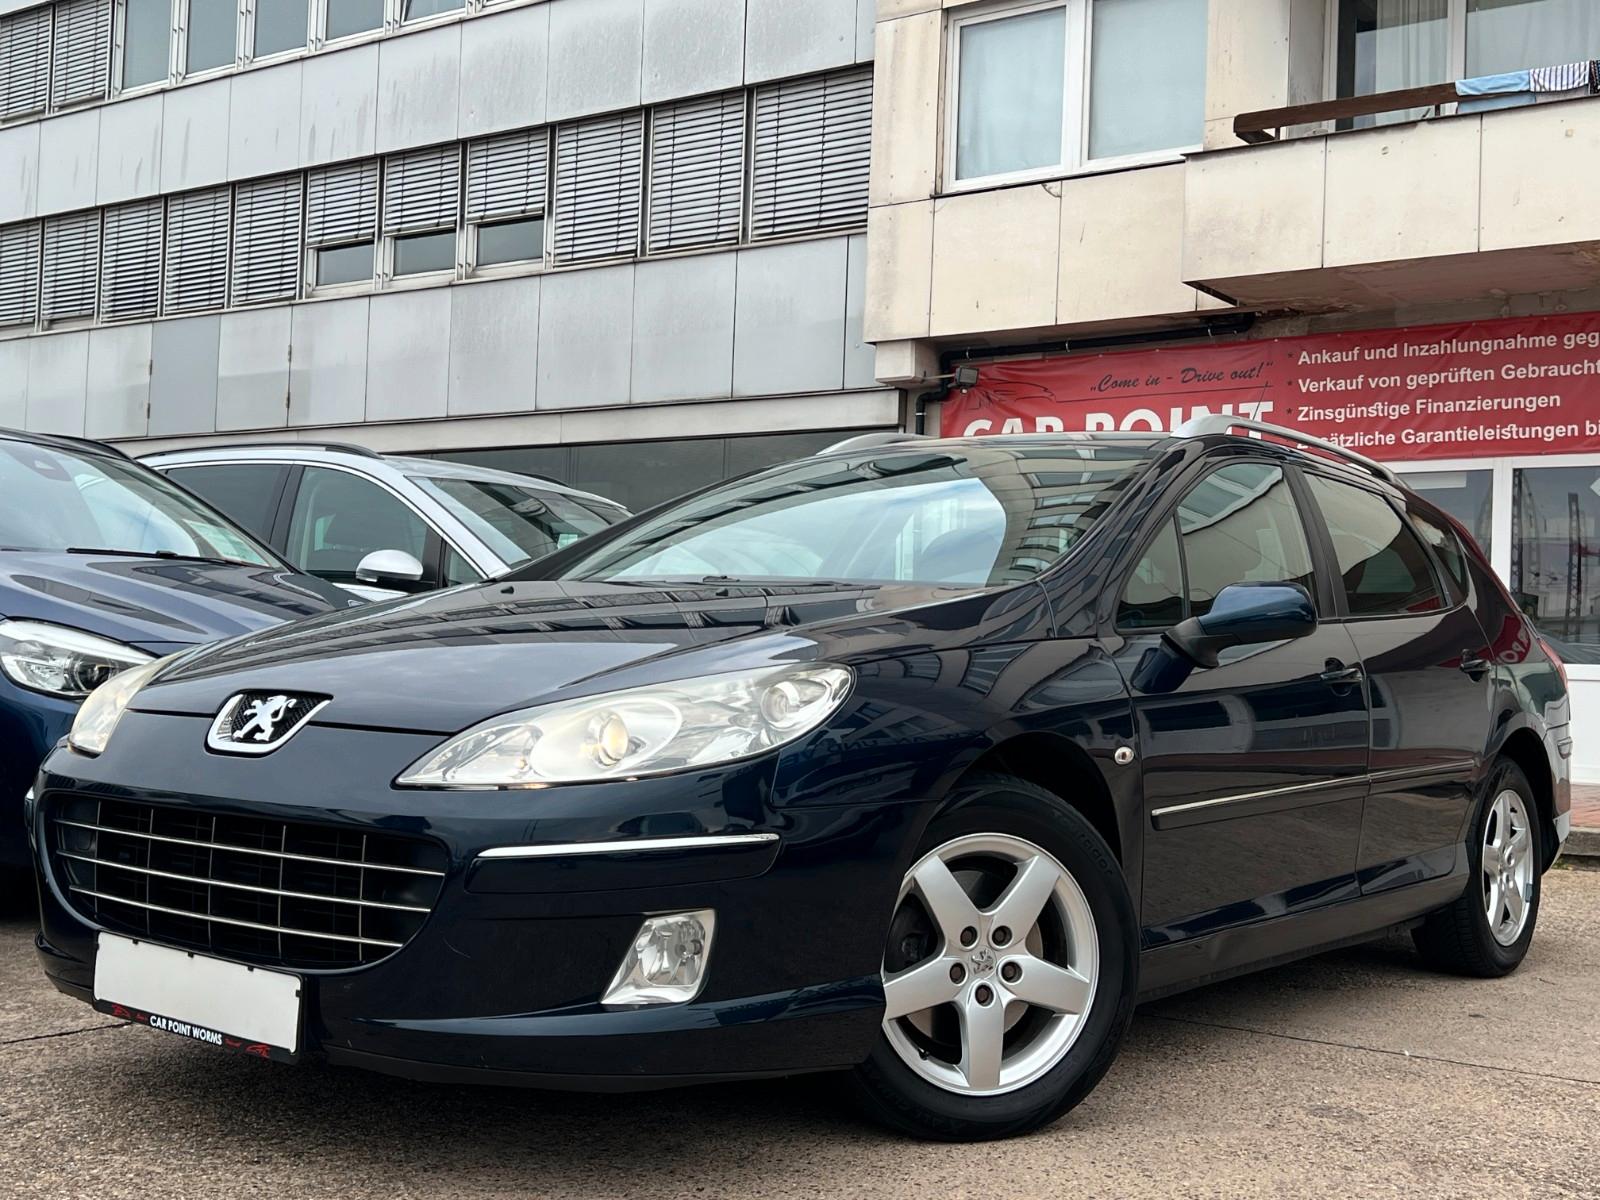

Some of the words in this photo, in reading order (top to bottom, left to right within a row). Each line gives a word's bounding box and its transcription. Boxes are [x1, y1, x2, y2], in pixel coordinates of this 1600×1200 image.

[1298, 346, 1360, 365] Ankauf
[1364, 344, 1398, 360] und
[1403, 333, 1557, 357] Inzahlungnahme
[1145, 375, 1161, 387] in
[1180, 367, 1225, 384] Drive
[1298, 375, 1364, 393] Verkauf
[1368, 375, 1401, 389] von
[1406, 367, 1495, 390] geprüften
[1297, 402, 1411, 423] Zinsgünstige
[1416, 394, 1561, 414] Finanzierungen
[1401, 423, 1579, 445] Garantieleistungen
[150, 1015, 167, 1030] CAR
[168, 1020, 191, 1036] POINT
[192, 1026, 223, 1046] WORMS
